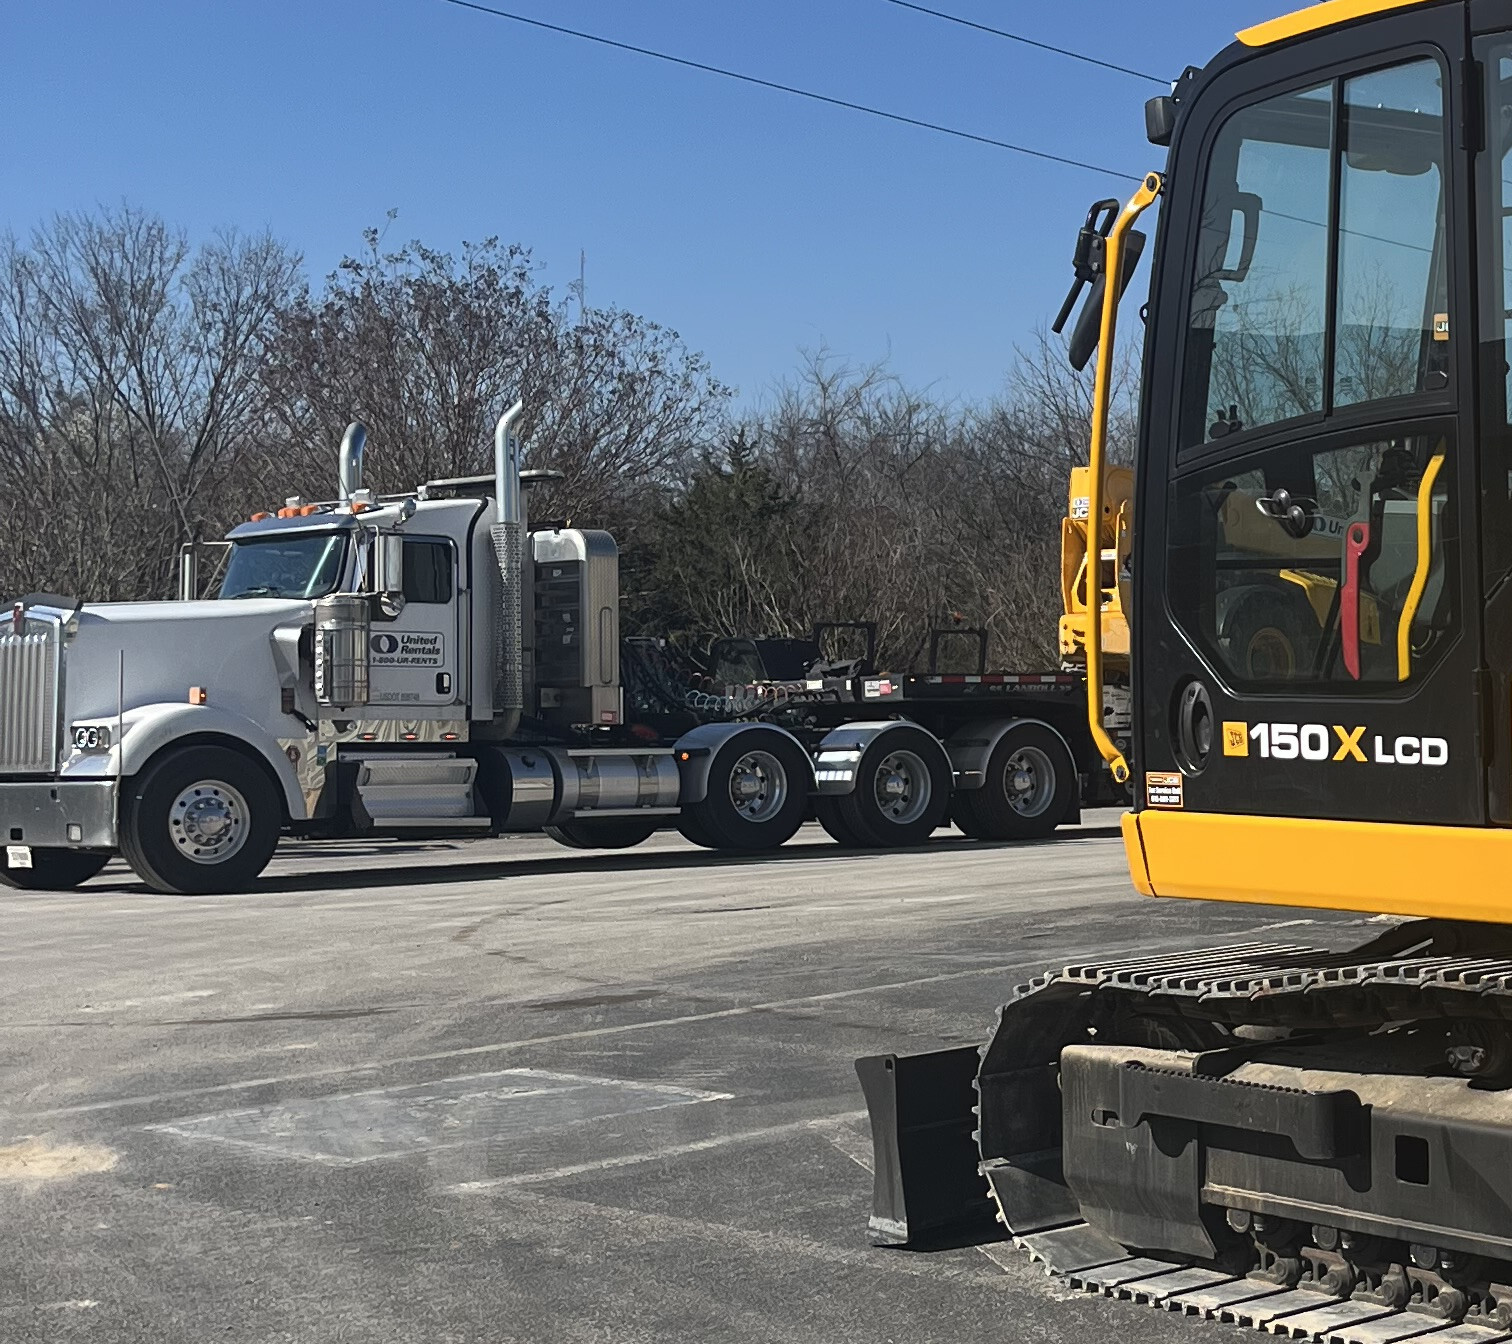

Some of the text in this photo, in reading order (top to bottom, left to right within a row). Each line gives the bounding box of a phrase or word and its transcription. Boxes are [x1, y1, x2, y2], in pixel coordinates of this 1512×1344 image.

[401, 635, 438, 645] United
[401, 645, 441, 655] Rentals
[1374, 735, 1449, 766] LCD
